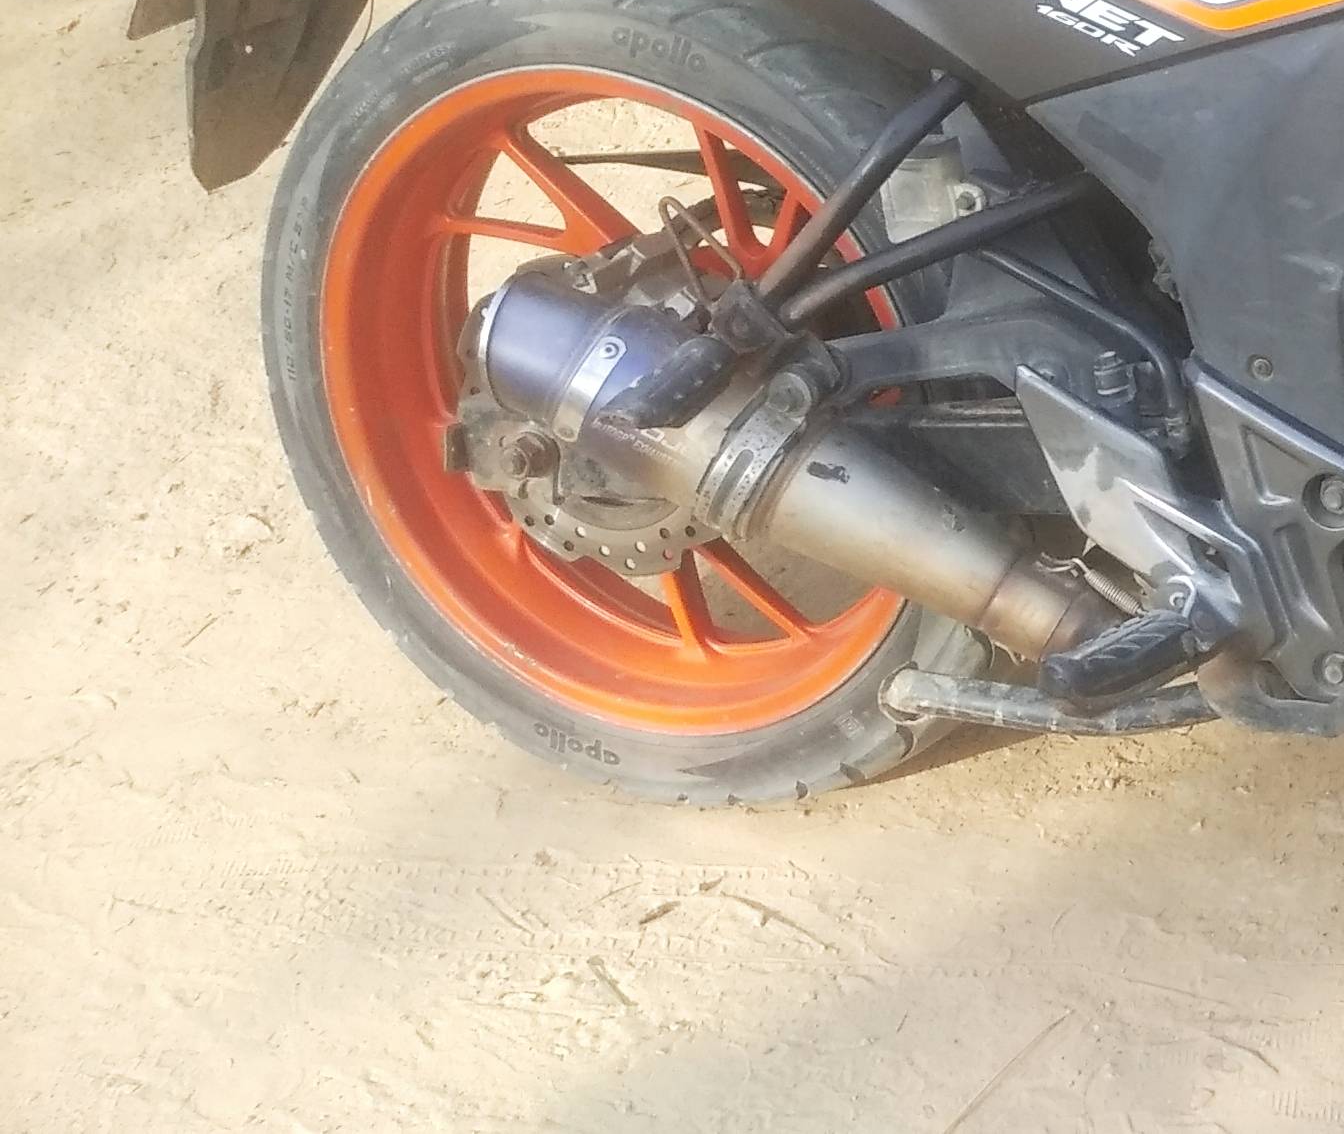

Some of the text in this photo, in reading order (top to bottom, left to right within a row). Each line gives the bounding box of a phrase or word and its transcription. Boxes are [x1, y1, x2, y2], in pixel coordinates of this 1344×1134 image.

[611, 26, 708, 74] apollo
[1035, 2, 1145, 58] 160R
[533, 722, 622, 766] apollo
